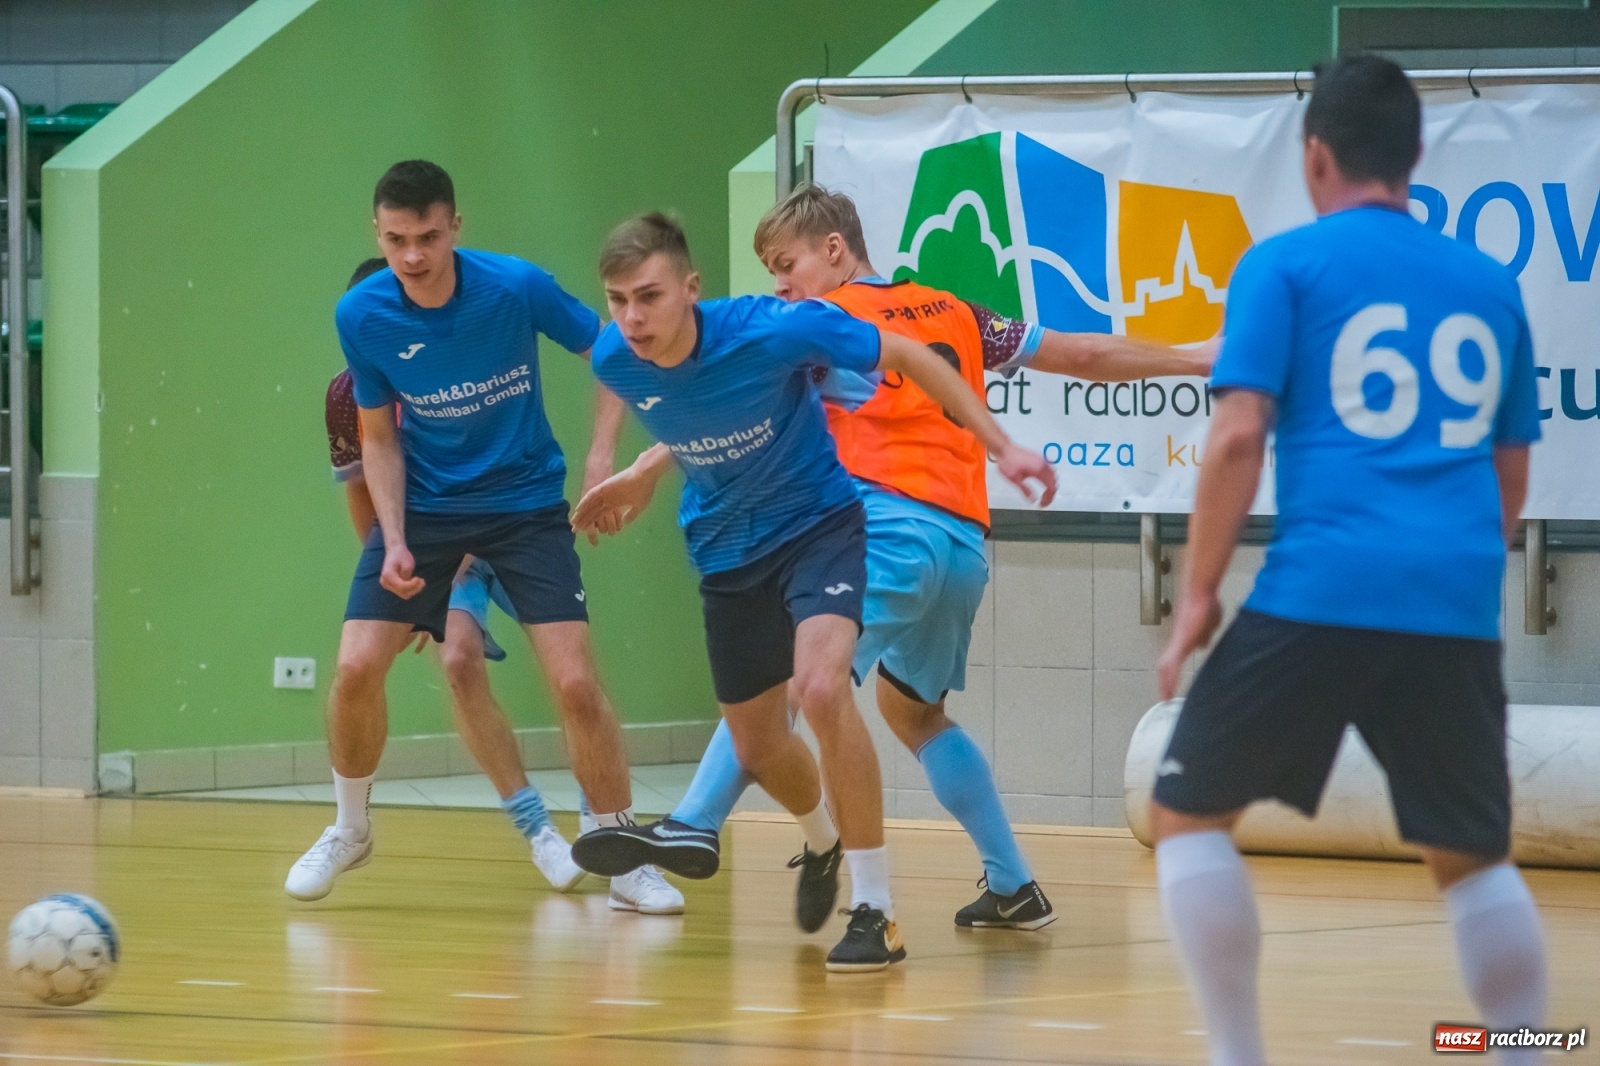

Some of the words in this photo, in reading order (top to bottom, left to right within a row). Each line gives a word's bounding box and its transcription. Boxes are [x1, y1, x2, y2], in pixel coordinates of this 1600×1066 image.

[400, 364, 530, 405] Marek&Dariusz
[1330, 302, 1502, 448] 69
[411, 402, 481, 418] Metallbau
[484, 380, 531, 406] GmbH
[727, 428, 774, 459] GmbH
[1043, 442, 1135, 466] oaza
